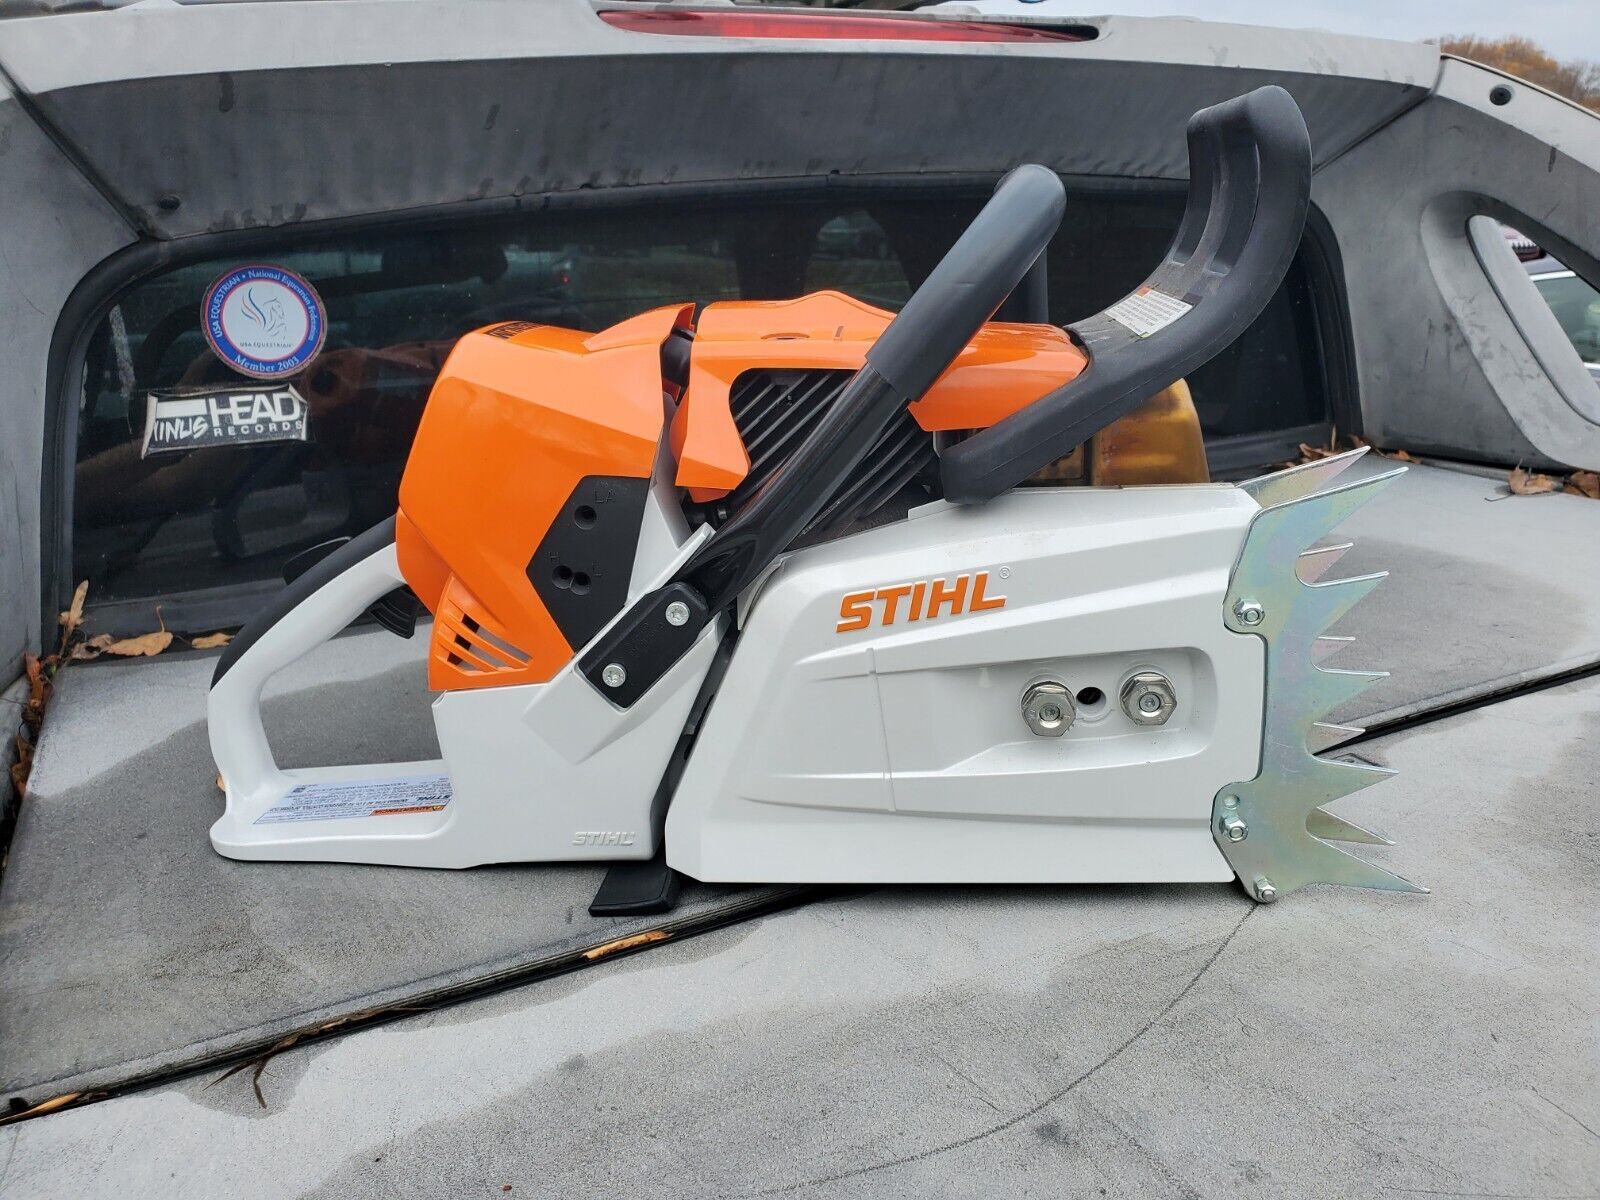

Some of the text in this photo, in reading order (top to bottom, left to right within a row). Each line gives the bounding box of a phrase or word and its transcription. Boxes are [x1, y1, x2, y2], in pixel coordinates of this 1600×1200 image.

[247, 270, 281, 281] National
[210, 275, 242, 321] EQUESTRIAN
[281, 275, 312, 307] Equestrian
[211, 321, 223, 339] USA
[234, 354, 300, 373] Member 2003
[208, 392, 301, 428] HEAD
[213, 420, 304, 438] RECORDS
[835, 570, 1008, 634] STIHL
[572, 831, 636, 847] STIHL
